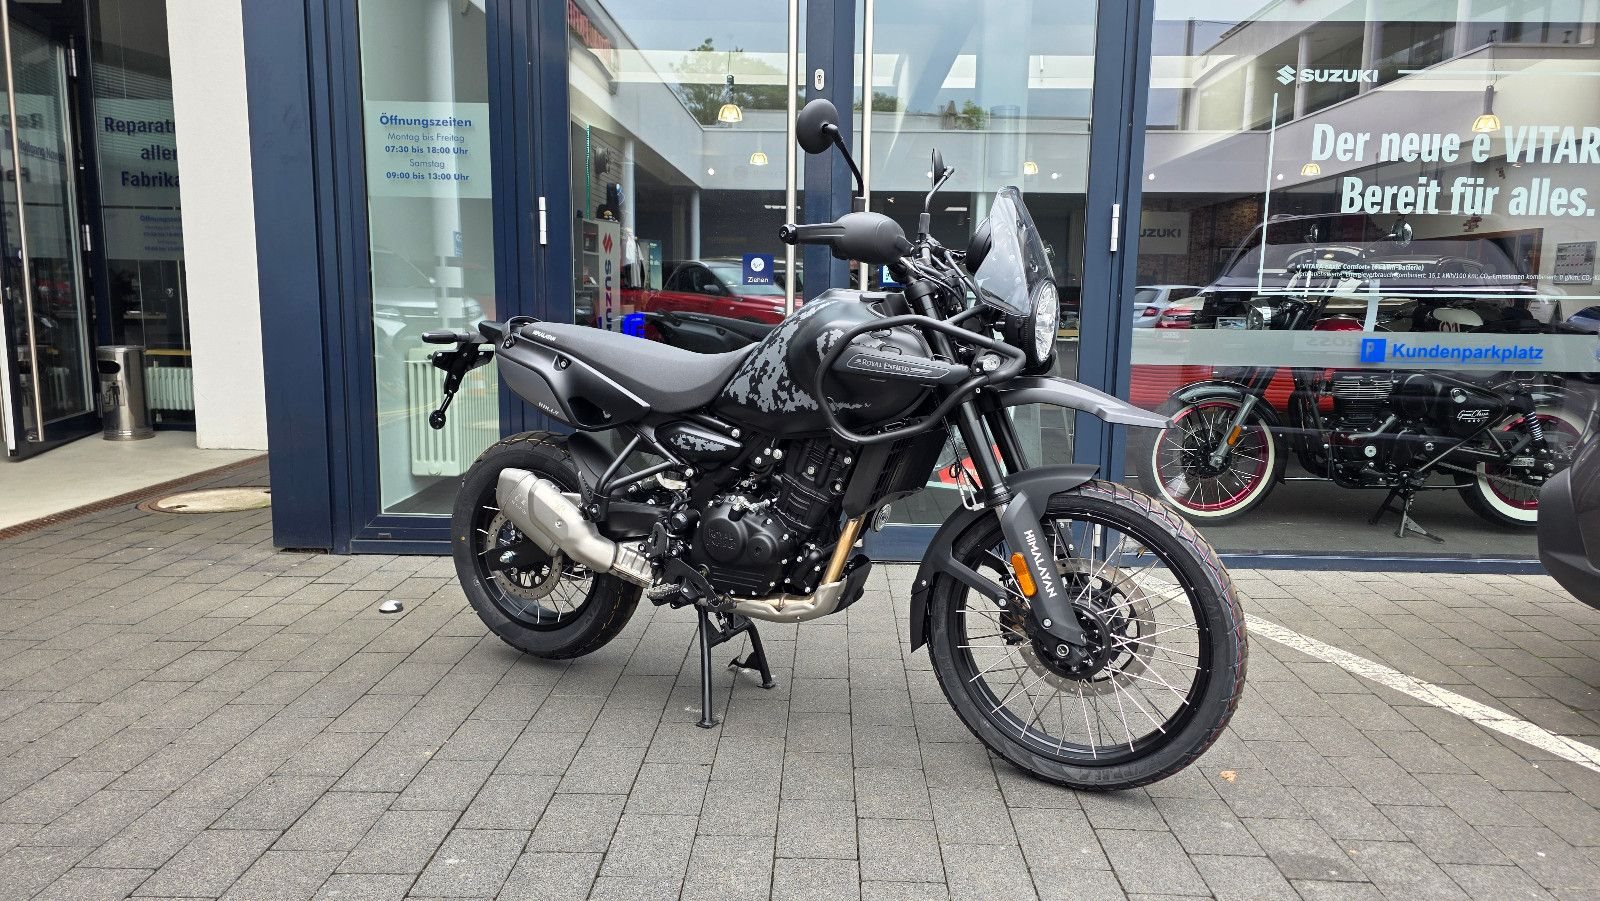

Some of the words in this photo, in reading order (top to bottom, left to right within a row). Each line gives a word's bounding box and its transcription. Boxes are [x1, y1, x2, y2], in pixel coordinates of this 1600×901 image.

[1299, 68, 1379, 83] SUZUKI
[379, 112, 472, 128] Öffnungszeiten
[387, 133, 420, 143] Montag
[422, 133, 434, 141] bis
[436, 133, 465, 143] Freitag
[1311, 123, 1370, 162] Der
[1381, 131, 1460, 163] neue
[1471, 131, 1491, 163] e
[384, 145, 409, 153] 07:30
[427, 146, 450, 154] 18:00
[452, 147, 469, 155] Uhr
[409, 159, 445, 169] Samstag
[386, 171, 410, 179] 09:00
[412, 172, 425, 180] bis
[428, 172, 451, 180] 13:00
[453, 173, 470, 181] Uhr
[1340, 176, 1441, 214] Bereit
[1450, 177, 1500, 215] für
[1508, 178, 1595, 217] alles.
[1391, 343, 1544, 361] Kundenparkplatz
[862, 358, 882, 368] ROYAL
[883, 361, 911, 373] ENFIELD
[1023, 529, 1058, 599] HIMALAYAN
